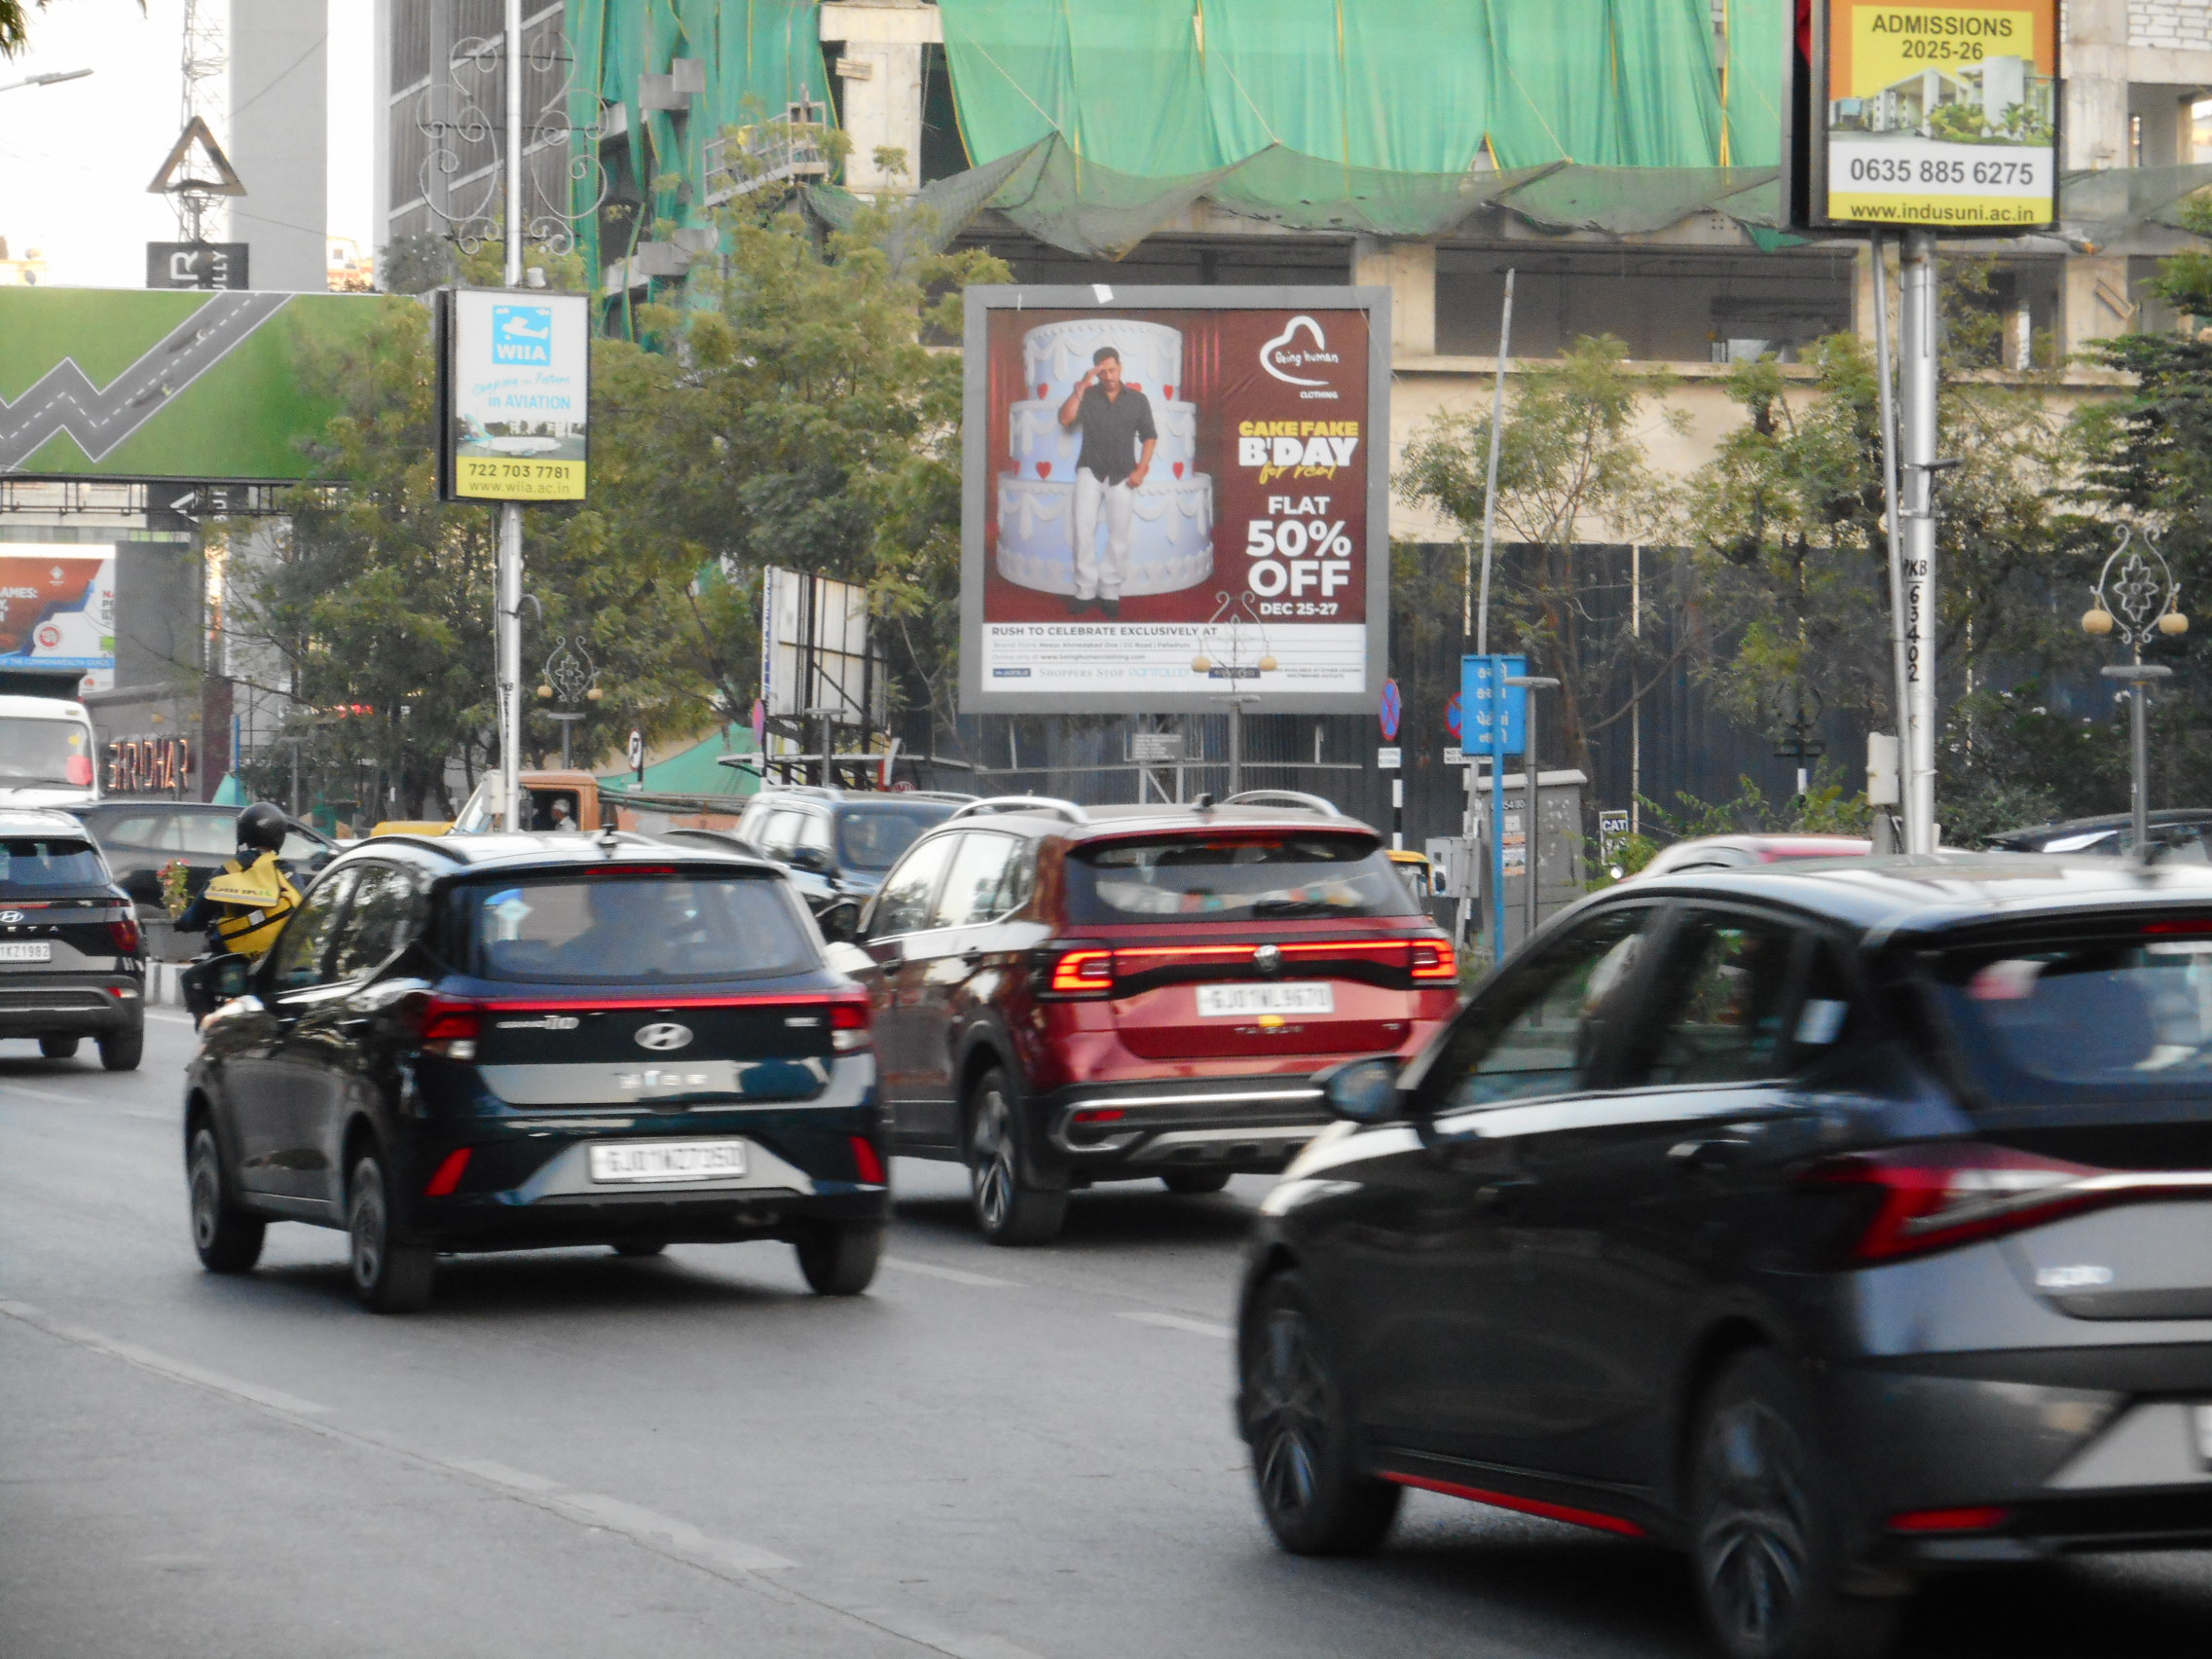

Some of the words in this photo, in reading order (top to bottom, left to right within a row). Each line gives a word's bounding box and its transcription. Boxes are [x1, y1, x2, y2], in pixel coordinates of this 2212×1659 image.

[1871, 14, 2013, 37] ADMISSIONS
[1901, 39, 1984, 60] 2025-26
[1850, 158, 1911, 182] 0635
[1919, 160, 1965, 184] 885
[1972, 162, 2034, 186] 6275
[1850, 203, 2035, 222] www.indusuni.ac.in
[497, 343, 548, 361] WIIA
[1275, 350, 1303, 366] Being
[1303, 350, 1340, 364] human
[488, 394, 501, 407] in
[504, 394, 571, 410] AVIATION
[1300, 391, 1339, 400] CLOTHING
[1238, 421, 1299, 437] CAKE
[1300, 421, 1359, 437] FAKE
[1238, 436, 1359, 467] B'DAY
[468, 462, 498, 477] 722
[502, 464, 531, 478] 703
[535, 465, 570, 479] 7781
[1259, 461, 1288, 485] for
[1293, 460, 1339, 481] real
[468, 481, 570, 495] www.wiia.ac.in
[1268, 496, 1331, 515] FLAT
[1245, 519, 1352, 557] 50%
[1247, 559, 1351, 597] OFF
[1260, 602, 1293, 615] DEC
[1296, 603, 1339, 615] 25-27
[992, 626, 1023, 636] RUSH
[1028, 626, 1045, 636] TO
[1048, 626, 1117, 636] CELEBRATE
[1121, 626, 1198, 636] EXCLUSIVELY
[1201, 626, 1218, 636] AT
[1039, 668, 1092, 678] SHOPPERS
[1096, 668, 1125, 678] STOP
